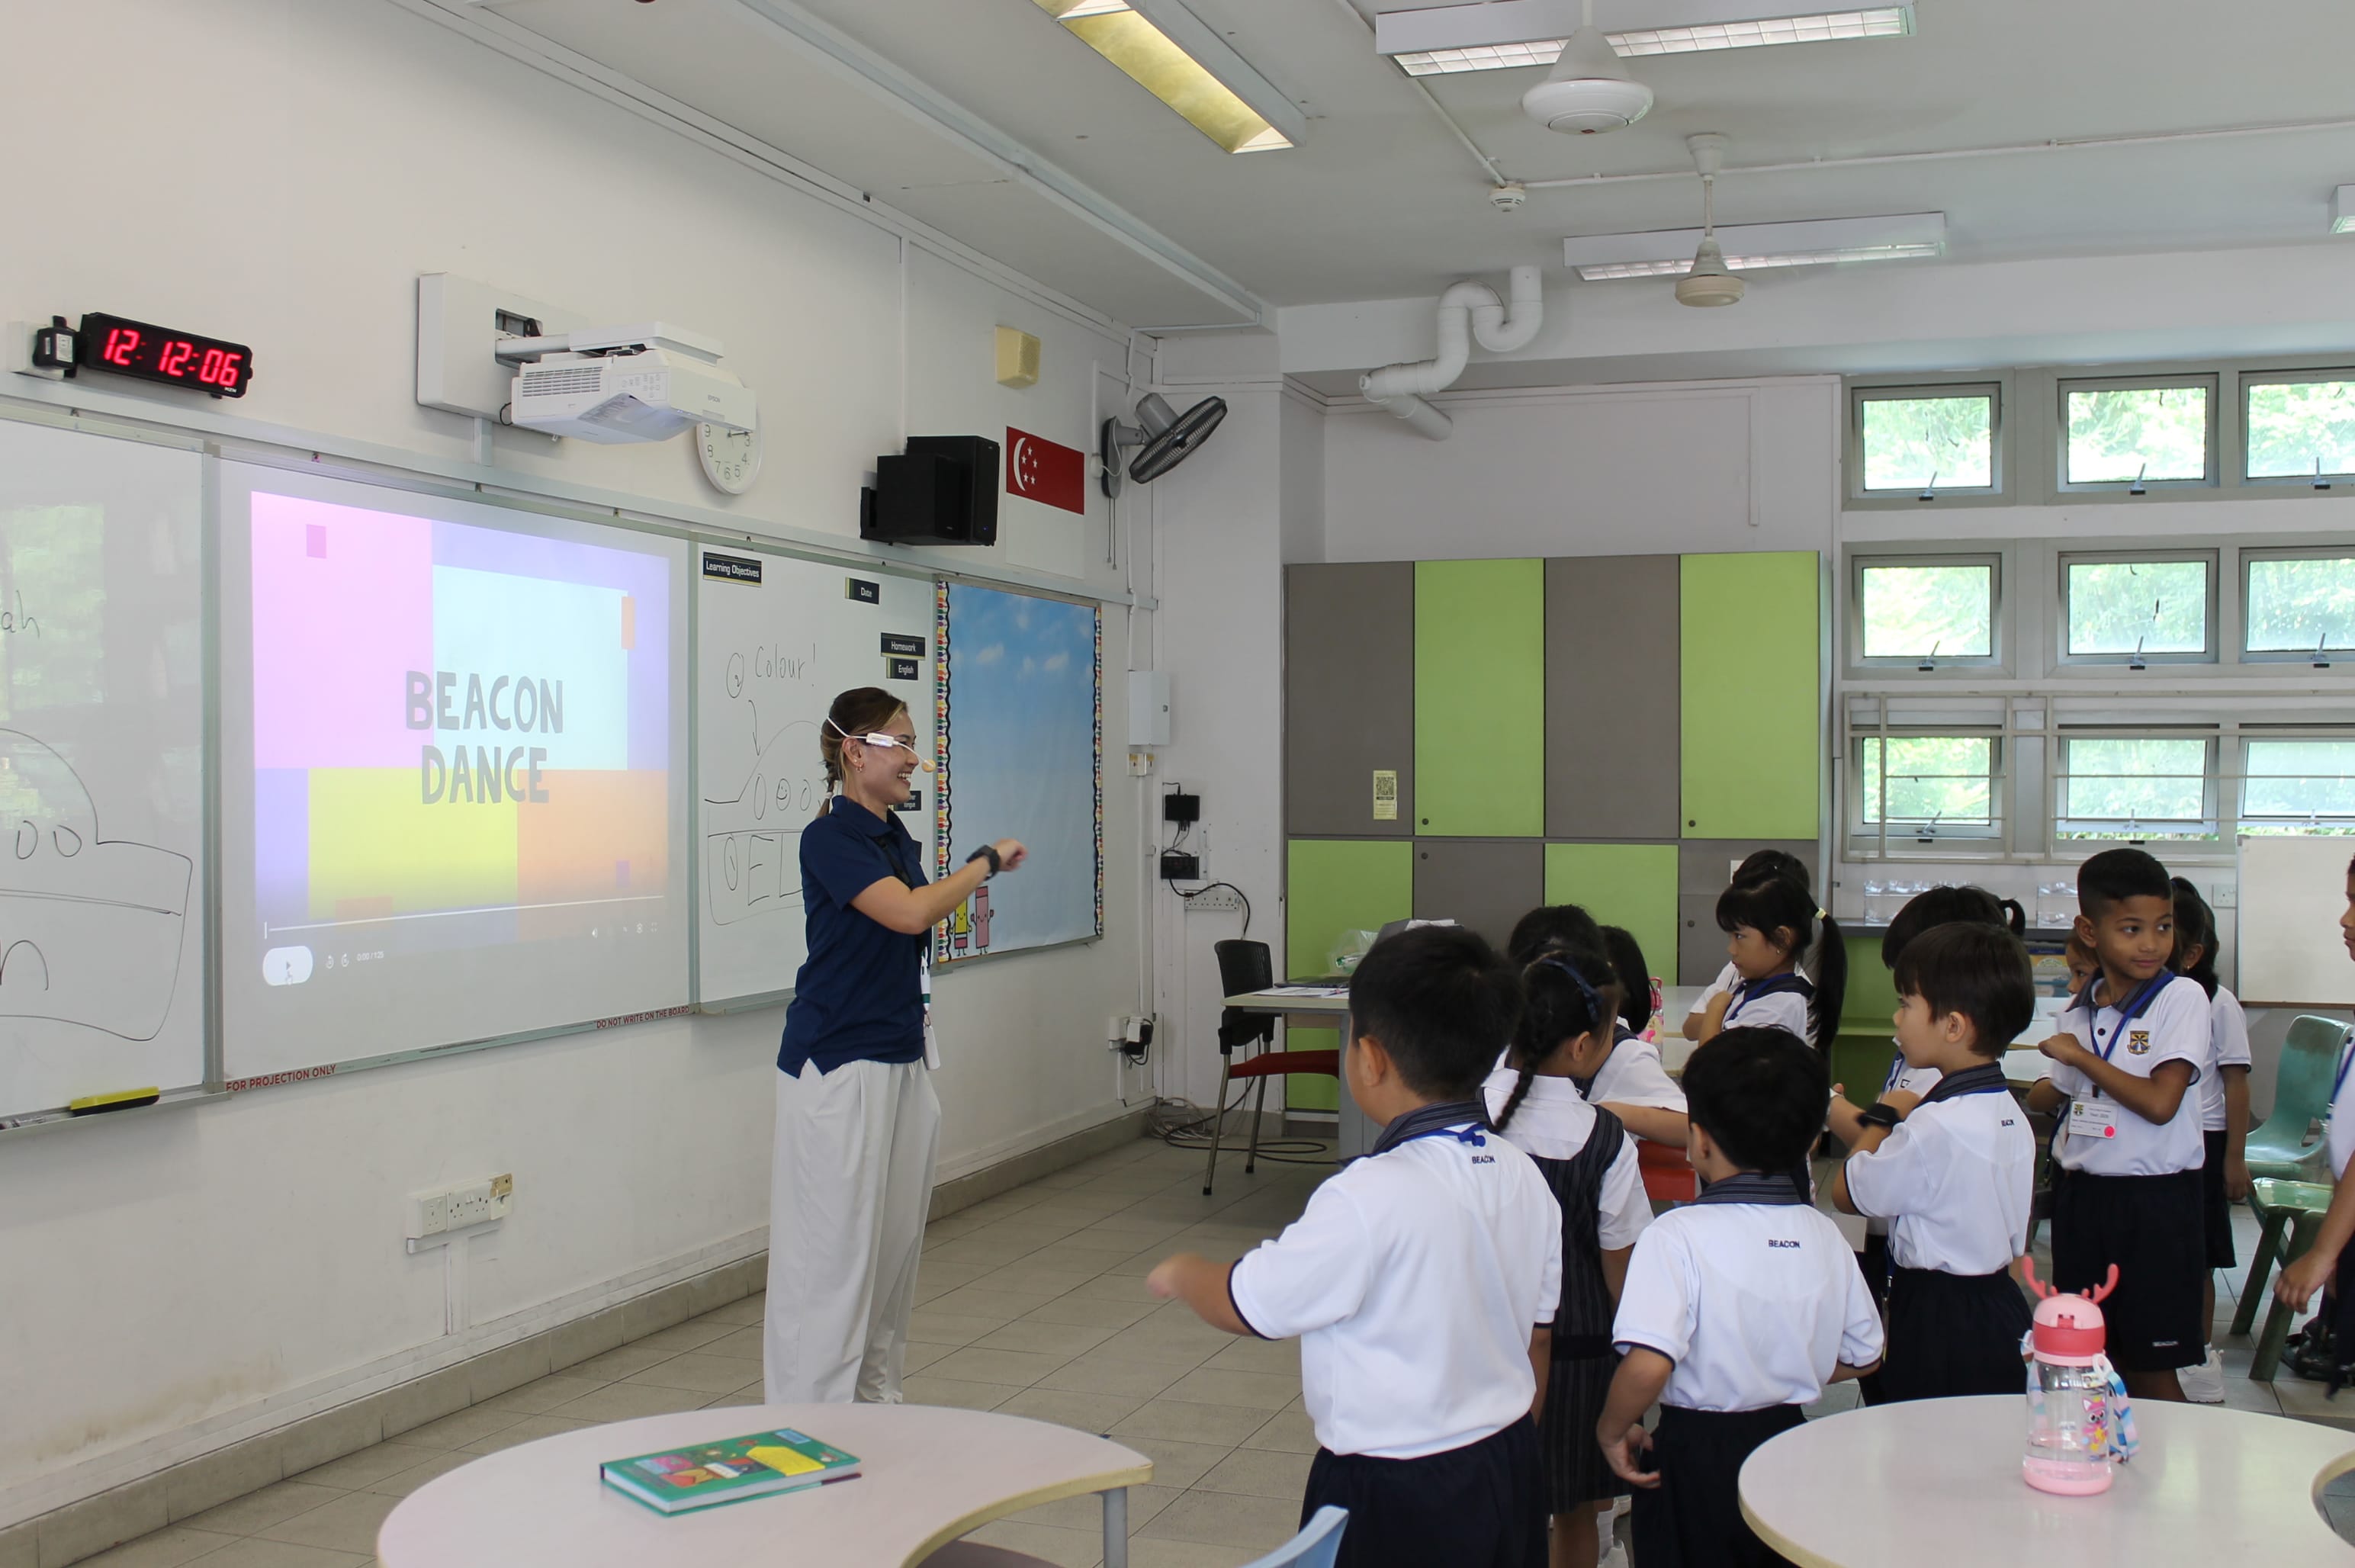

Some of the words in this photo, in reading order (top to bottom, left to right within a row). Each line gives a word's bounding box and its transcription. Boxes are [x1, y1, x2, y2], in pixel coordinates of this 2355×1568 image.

[705, 561, 731, 576] Learning
[732, 564, 760, 578] Objectives
[860, 586, 872, 598] Date
[891, 641, 916, 653] Homework
[898, 664, 914, 676] English
[406, 670, 563, 734] BEACON
[422, 744, 549, 805] DANCE
[596, 1020, 606, 1029] DO
[608, 1017, 622, 1028] NOT
[623, 1013, 643, 1024] WRITE
[644, 1011, 654, 1020] ON
[656, 1009, 667, 1019] THE
[668, 1005, 689, 1016] BOARD
[226, 1080, 246, 1091] FOR
[249, 1069, 310, 1088] PROJECTION
[312, 1064, 336, 1078] ONLY
[1472, 1155, 1496, 1165] BEACON
[1769, 1239, 1801, 1249] BEACON
